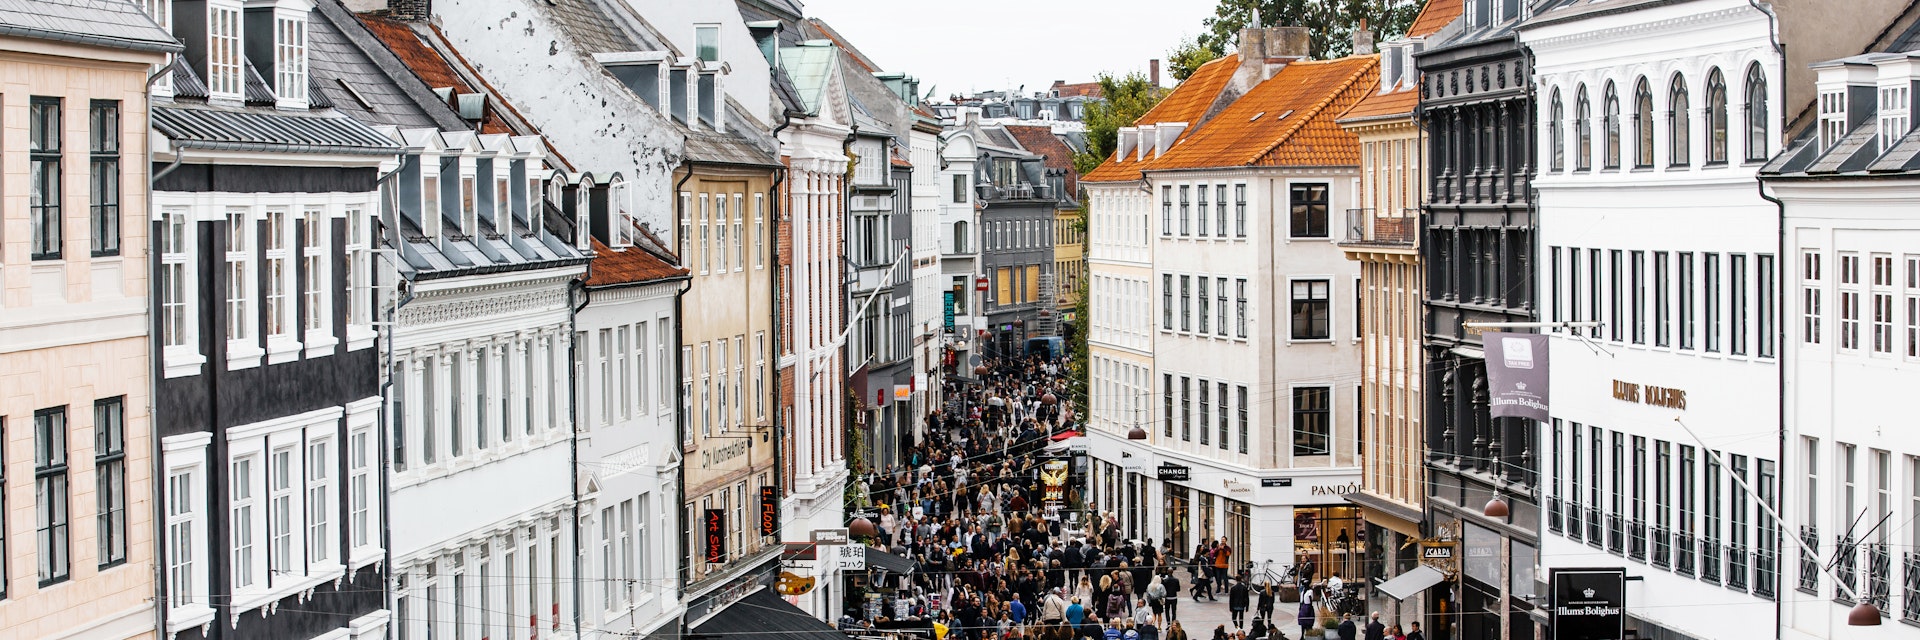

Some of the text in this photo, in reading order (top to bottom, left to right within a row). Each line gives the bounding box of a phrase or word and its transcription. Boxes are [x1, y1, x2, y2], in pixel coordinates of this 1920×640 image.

[1613, 379, 1686, 410] ILLUMS BOLIGHUS
[1492, 397, 1548, 411] Illums Bolighus
[762, 489, 775, 535] 1. Floor
[707, 511, 721, 562] Art Shop
[840, 546, 864, 558] 琥珀
[1425, 548, 1451, 556] SCARPA
[840, 560, 864, 568] コハク
[1558, 606, 1619, 617] Illums Bolighus
